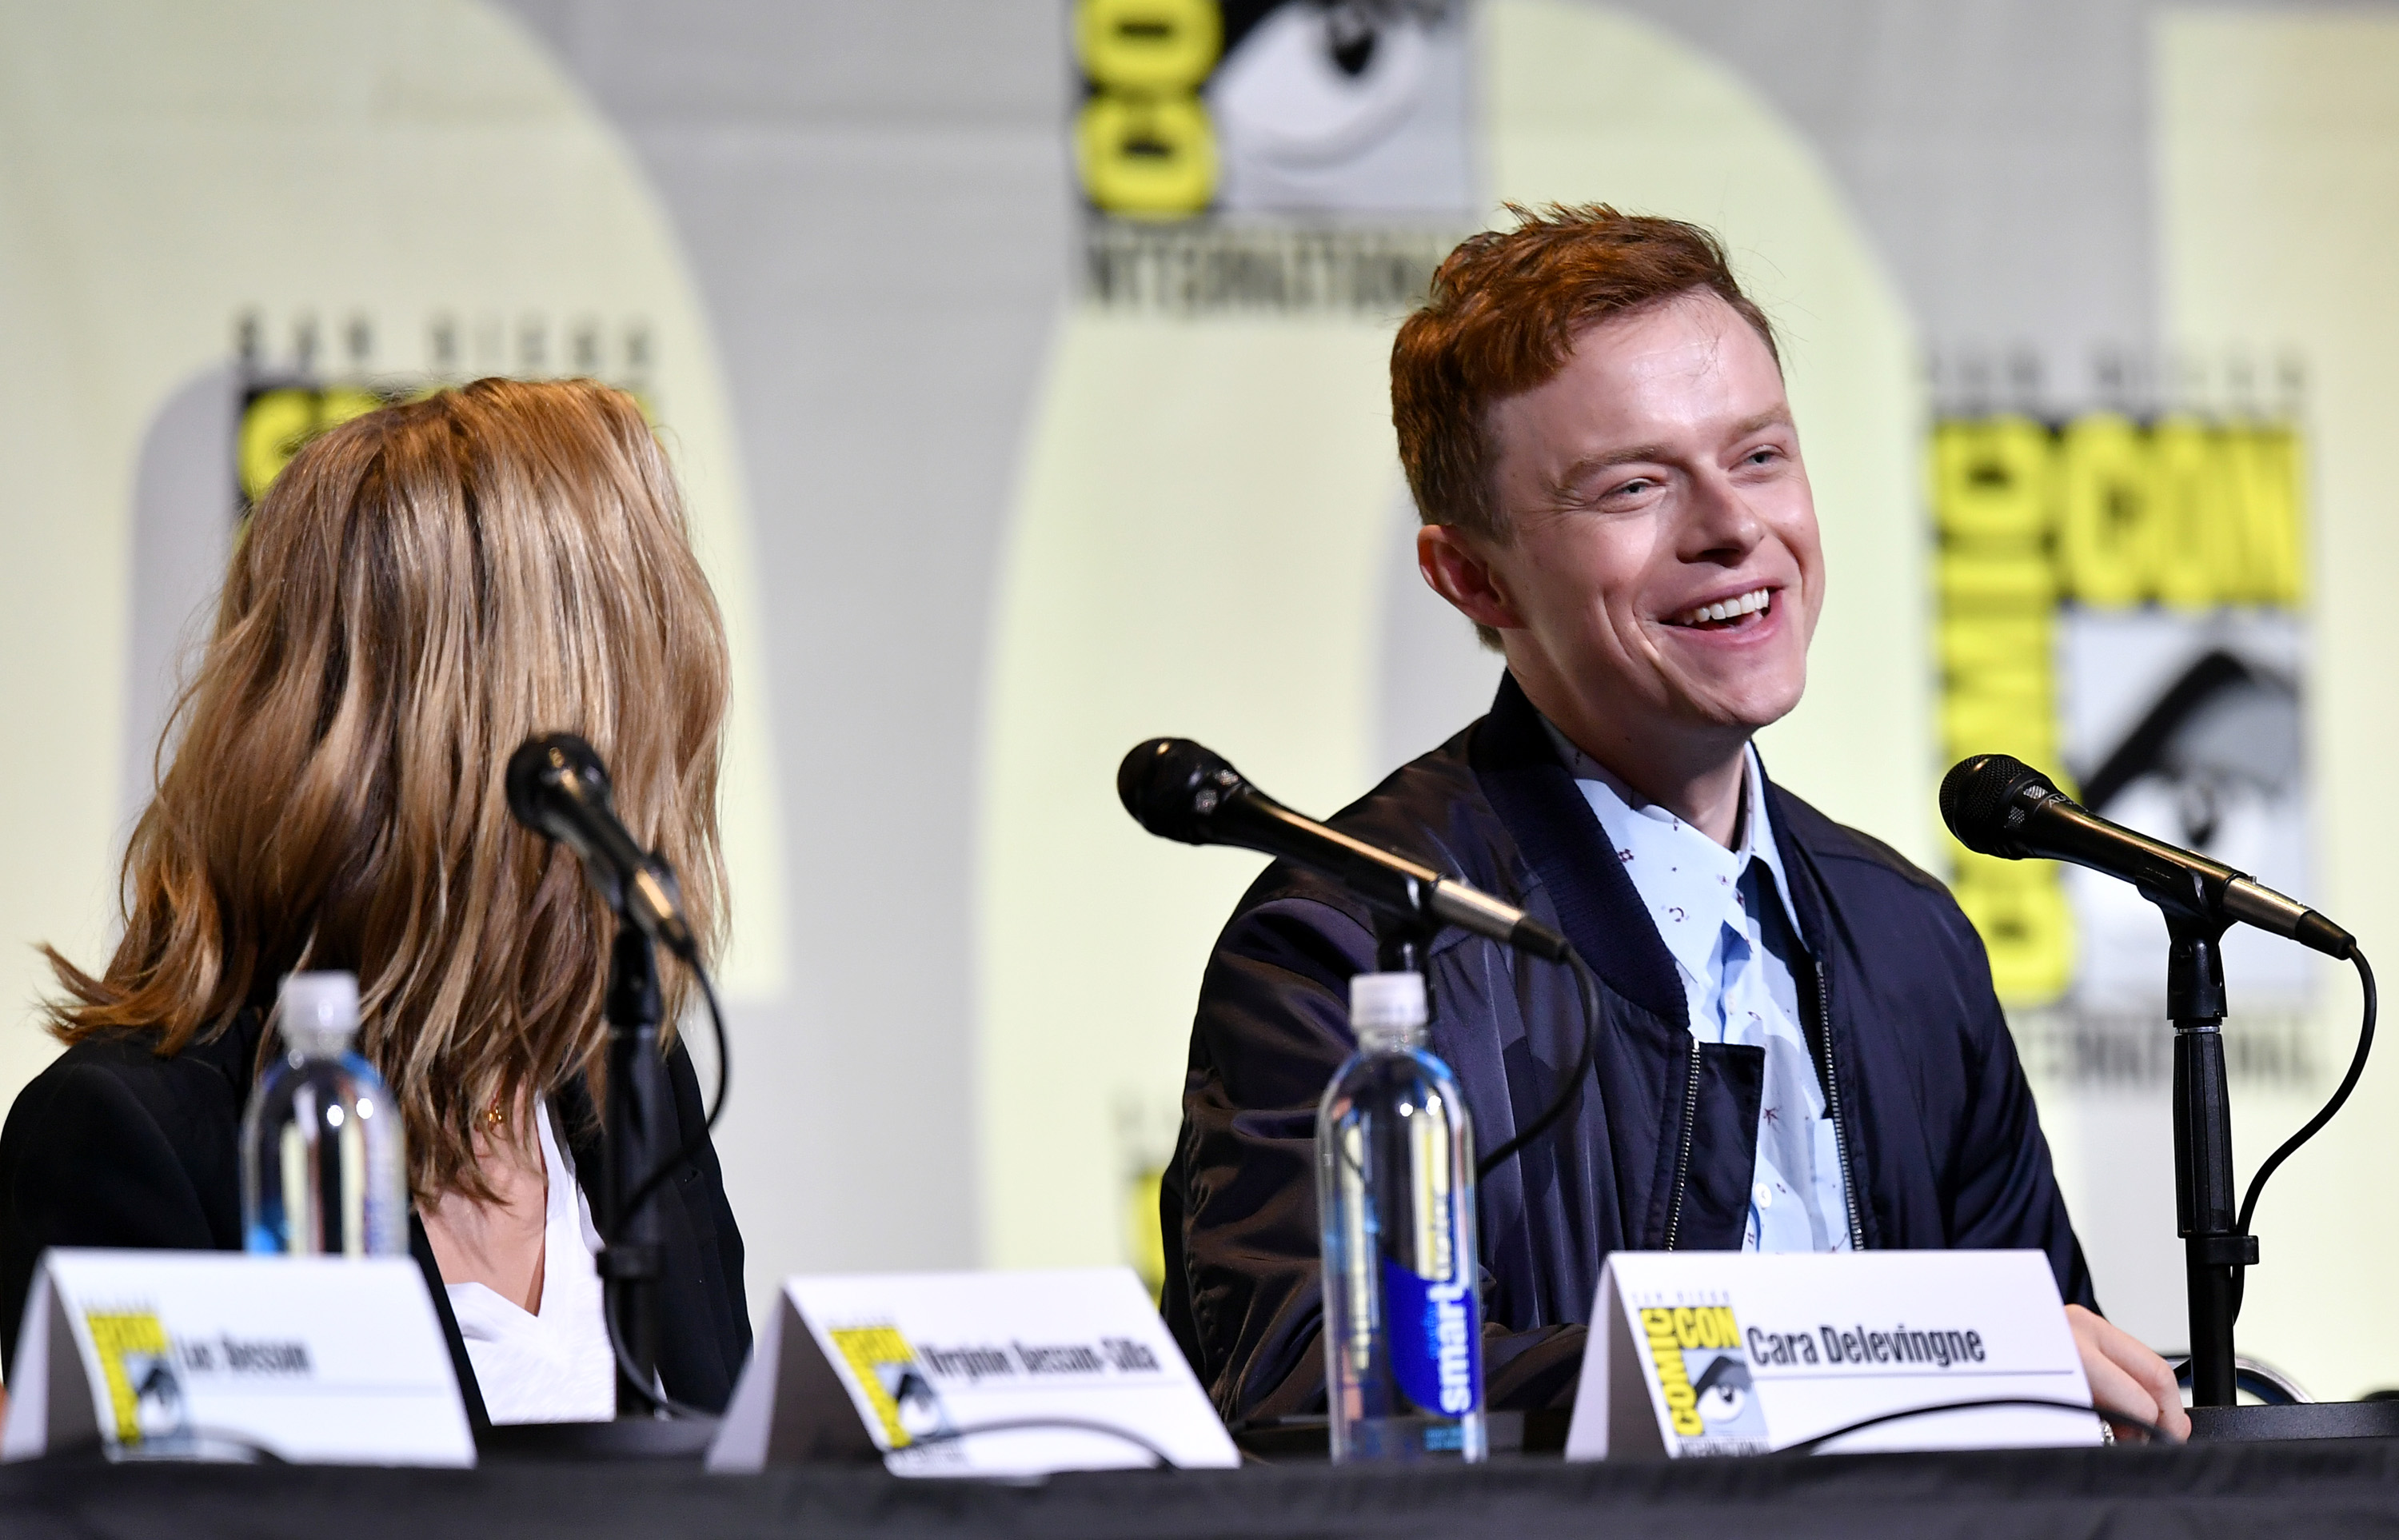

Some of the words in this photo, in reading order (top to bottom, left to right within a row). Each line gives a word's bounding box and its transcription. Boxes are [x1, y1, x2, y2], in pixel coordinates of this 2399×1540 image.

[2062, 413, 2303, 612] CON
[1674, 1306, 1742, 1349] CON
[1746, 1326, 1820, 1366] Cara
[1819, 1323, 1986, 1367] Delevingne
[1639, 1307, 1705, 1437] COMIC
